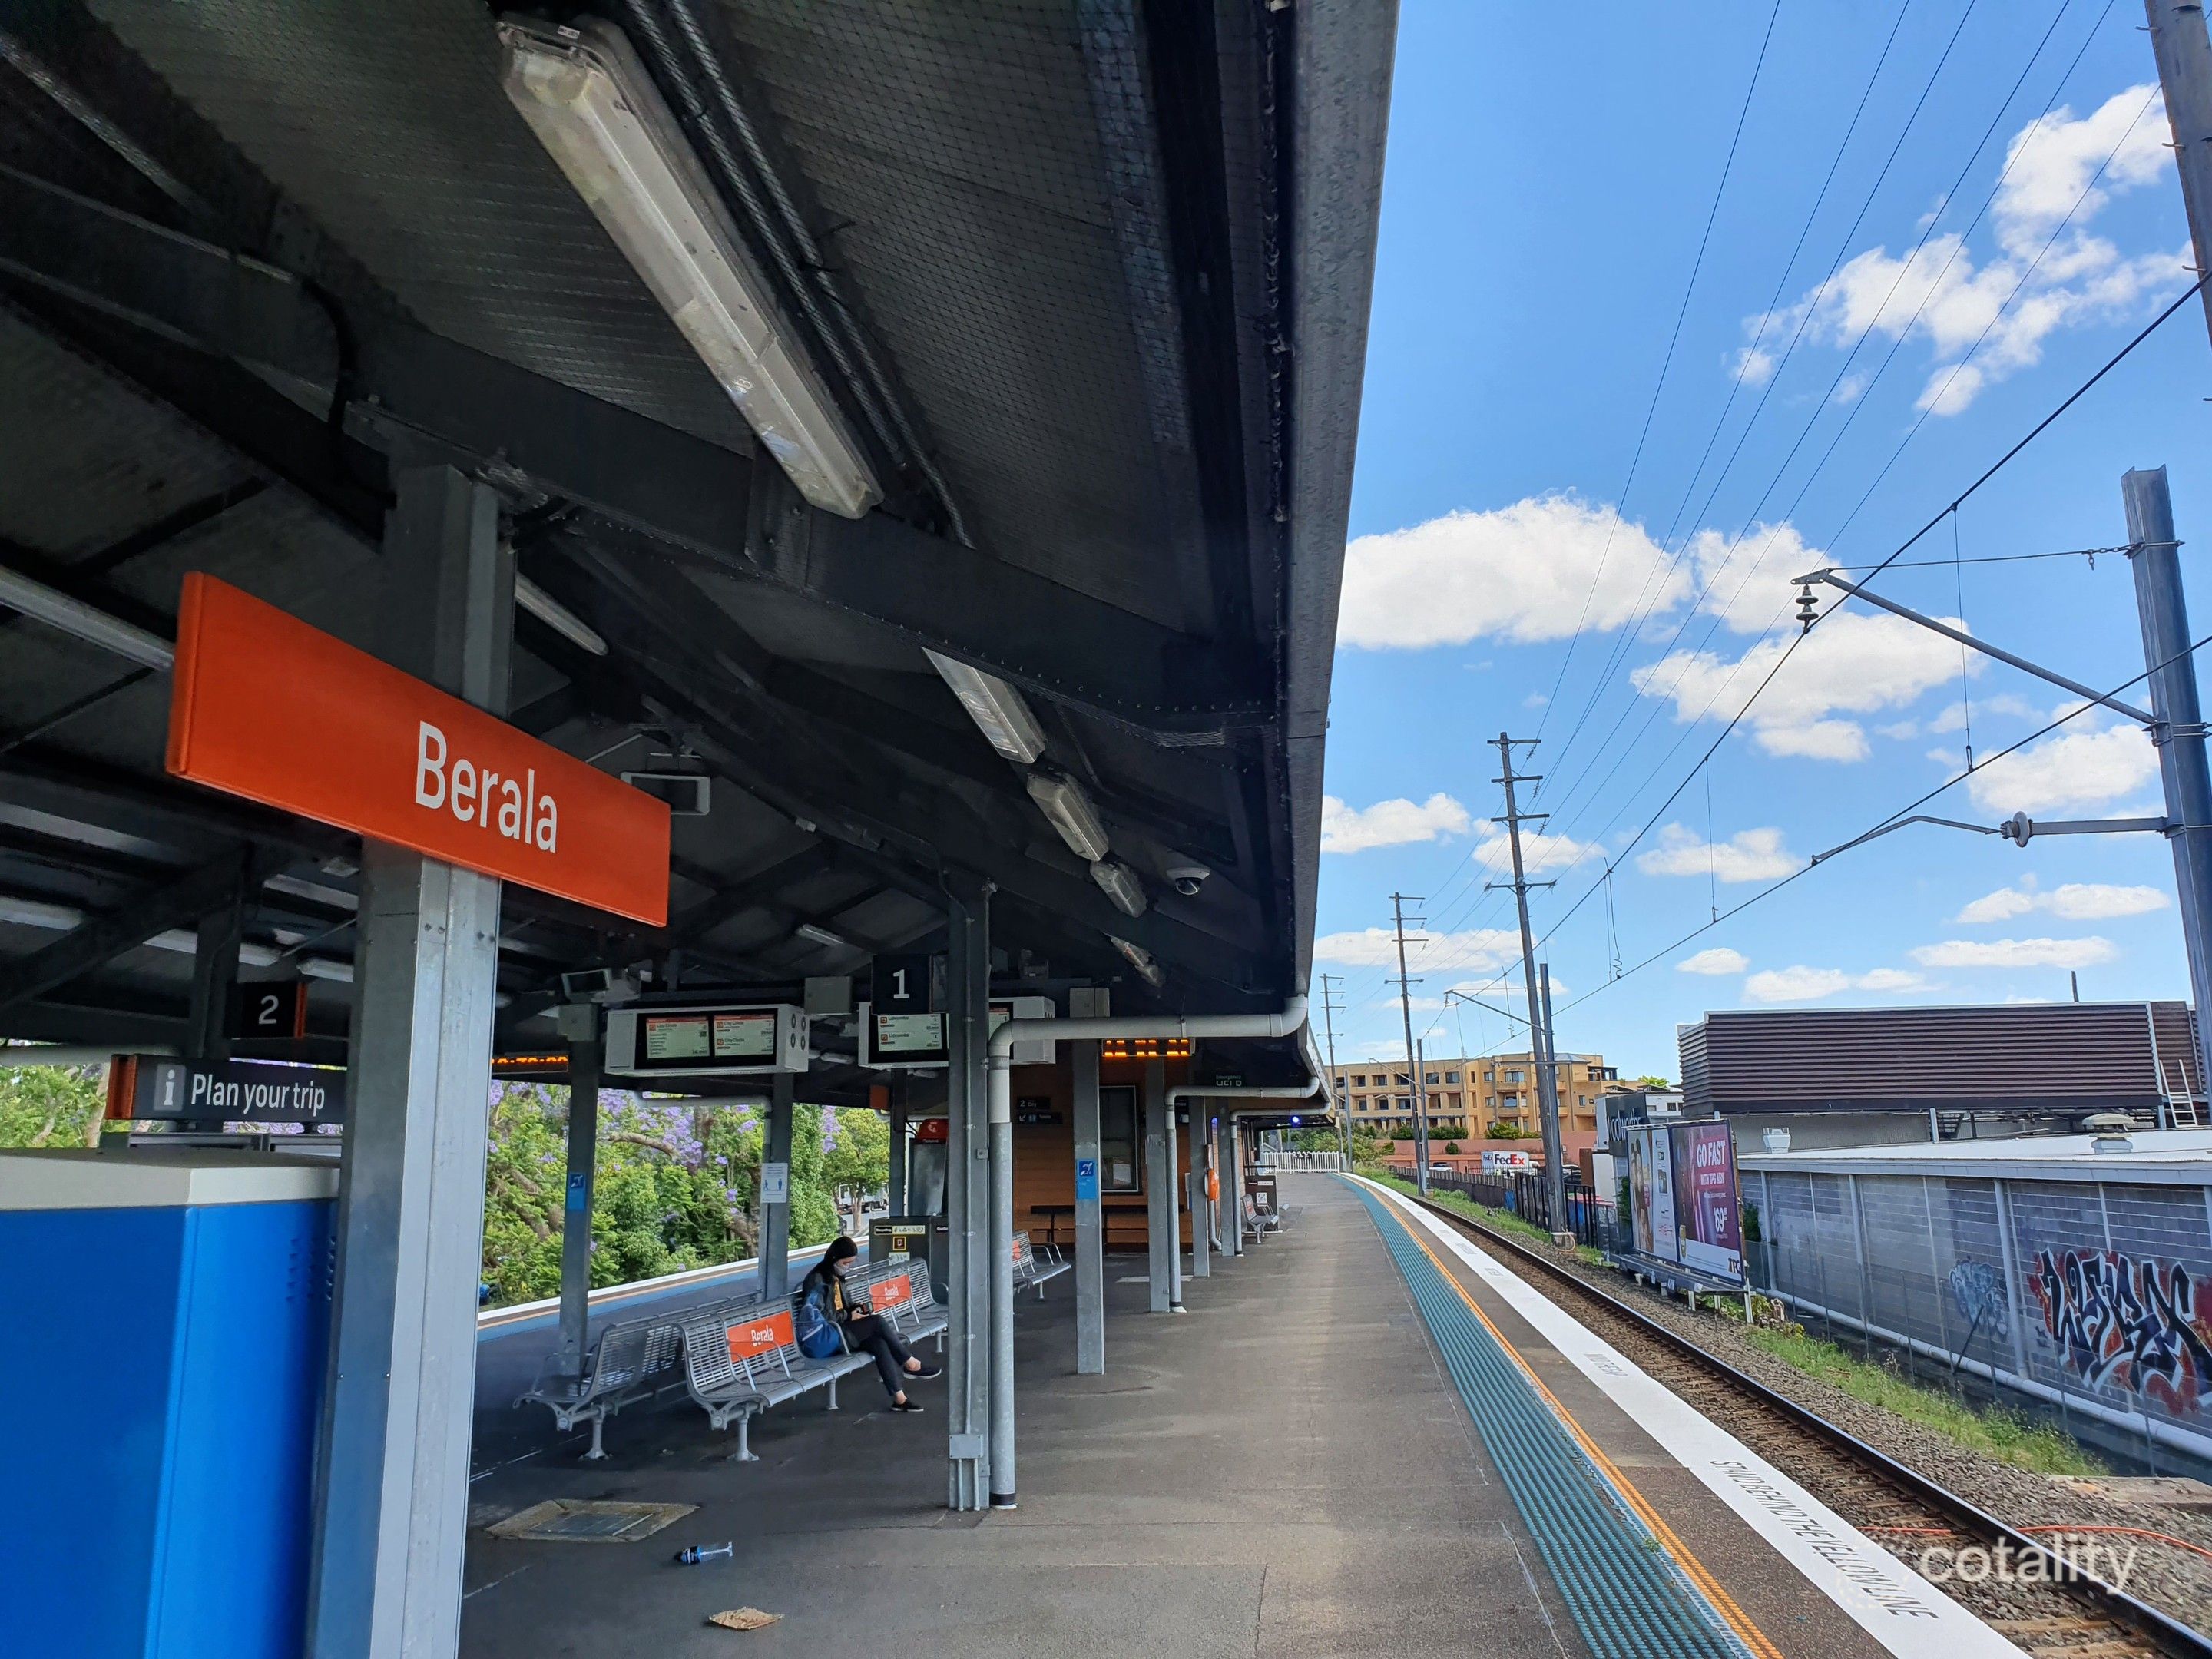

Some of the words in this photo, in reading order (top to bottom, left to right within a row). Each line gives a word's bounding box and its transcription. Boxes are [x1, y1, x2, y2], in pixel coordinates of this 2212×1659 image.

[415, 720, 558, 853] Berala
[892, 969, 910, 998] 1
[258, 995, 279, 1025] 2
[191, 1074, 239, 1106] Plan
[243, 1084, 290, 1115] your
[293, 1081, 325, 1117] trip
[1494, 1154, 1525, 1165] FedEx
[1697, 1144, 1707, 1167] GO
[1707, 1140, 1726, 1166] FAST
[751, 1324, 774, 1347] Berala
[1710, 1460, 1766, 1484] STAND
[1740, 1484, 1808, 1518] BEHIND
[1780, 1518, 1836, 1538] THE
[1806, 1540, 1899, 1588] YELLOW
[1861, 1587, 1940, 1619] LINE
